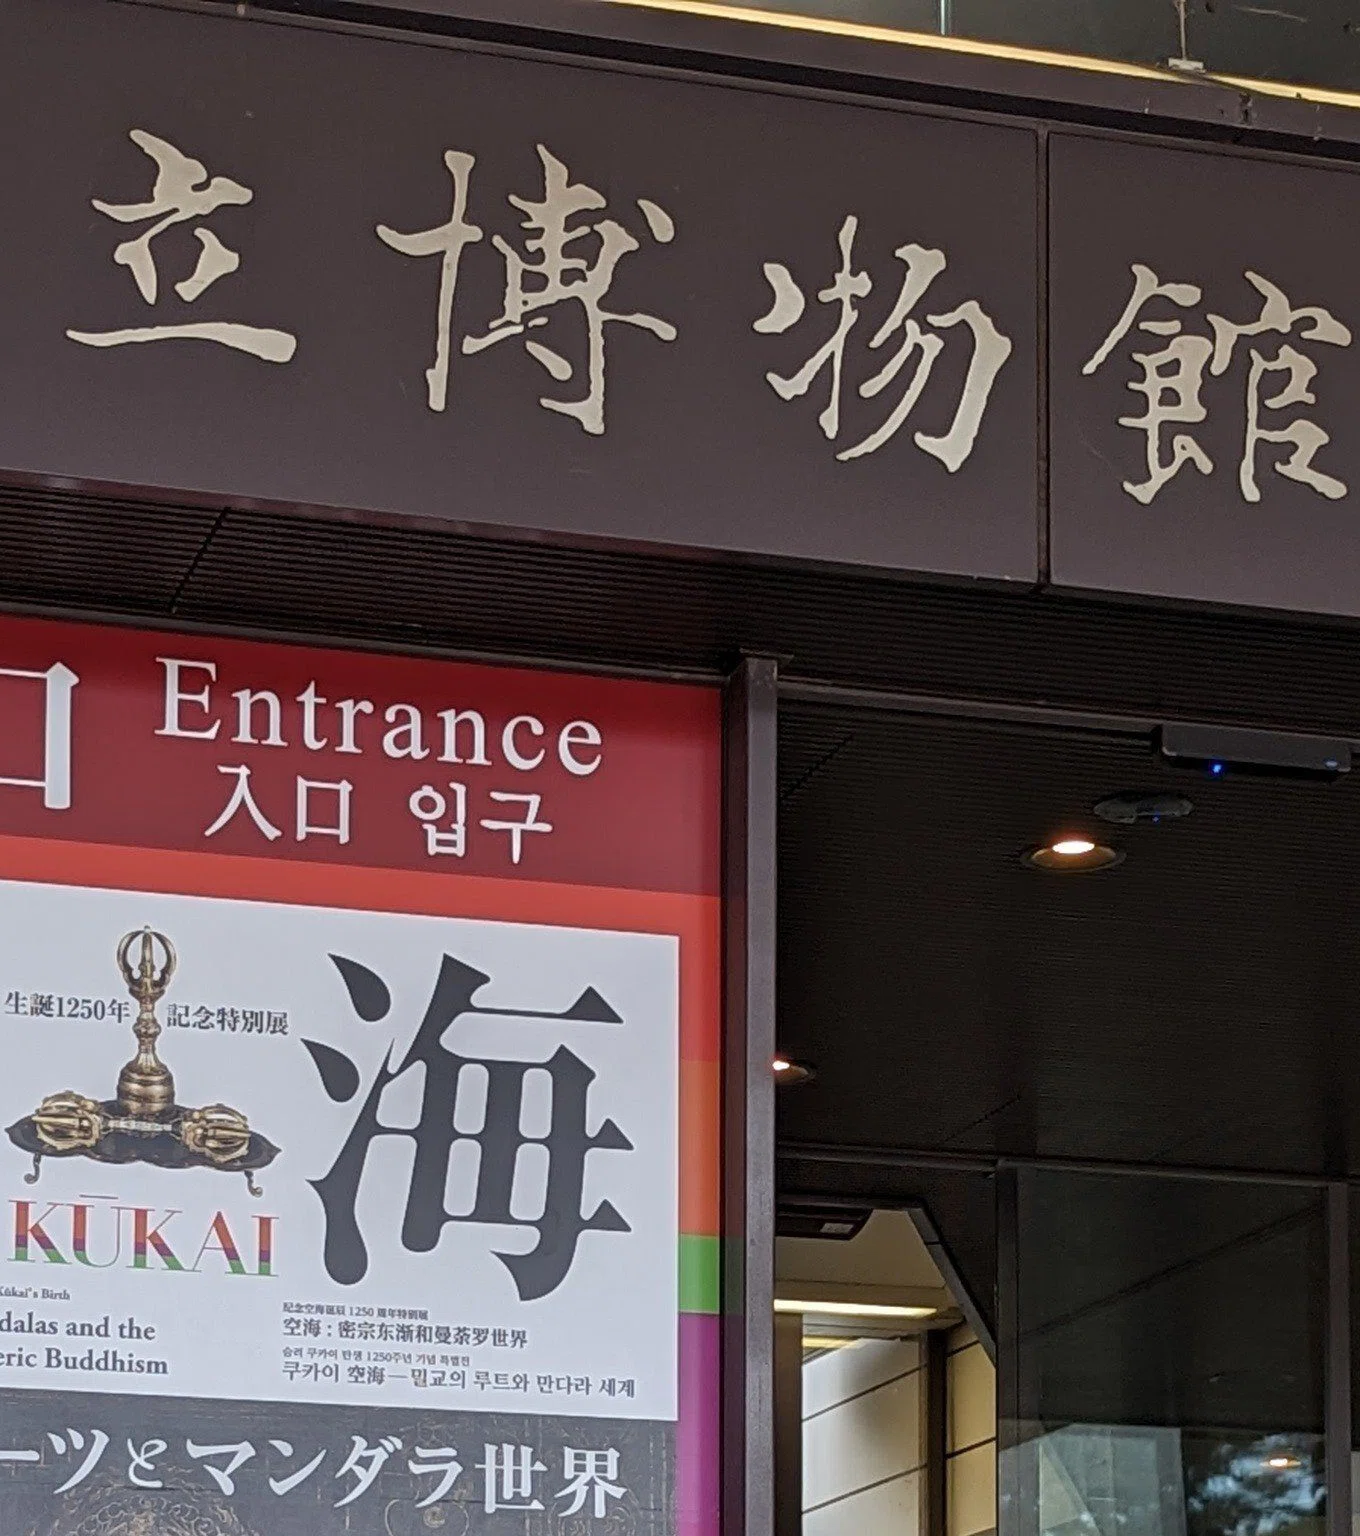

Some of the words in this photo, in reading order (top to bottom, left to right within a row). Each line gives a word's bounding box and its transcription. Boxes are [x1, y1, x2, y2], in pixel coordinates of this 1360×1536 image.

[154, 656, 606, 776] Entrance
[203, 765, 356, 845] 入口
[407, 780, 556, 866] 입구
[4, 990, 131, 1025] 生誕1250年
[167, 1003, 290, 1036] 記念特別展
[7, 1194, 280, 1278] KŪKAI
[40, 1288, 72, 1302] Birth
[349, 1306, 373, 1317] 1250
[65, 1315, 111, 1338] and
[117, 1316, 156, 1341] the
[44, 1347, 169, 1375] Buddhism
[367, 1351, 412, 1365] 1250주년
[282, 1361, 339, 1383] 쿠카이
[473, 1370, 531, 1394] 루트와
[537, 1373, 592, 1397] 만다라
[598, 1375, 636, 1399] 세계
